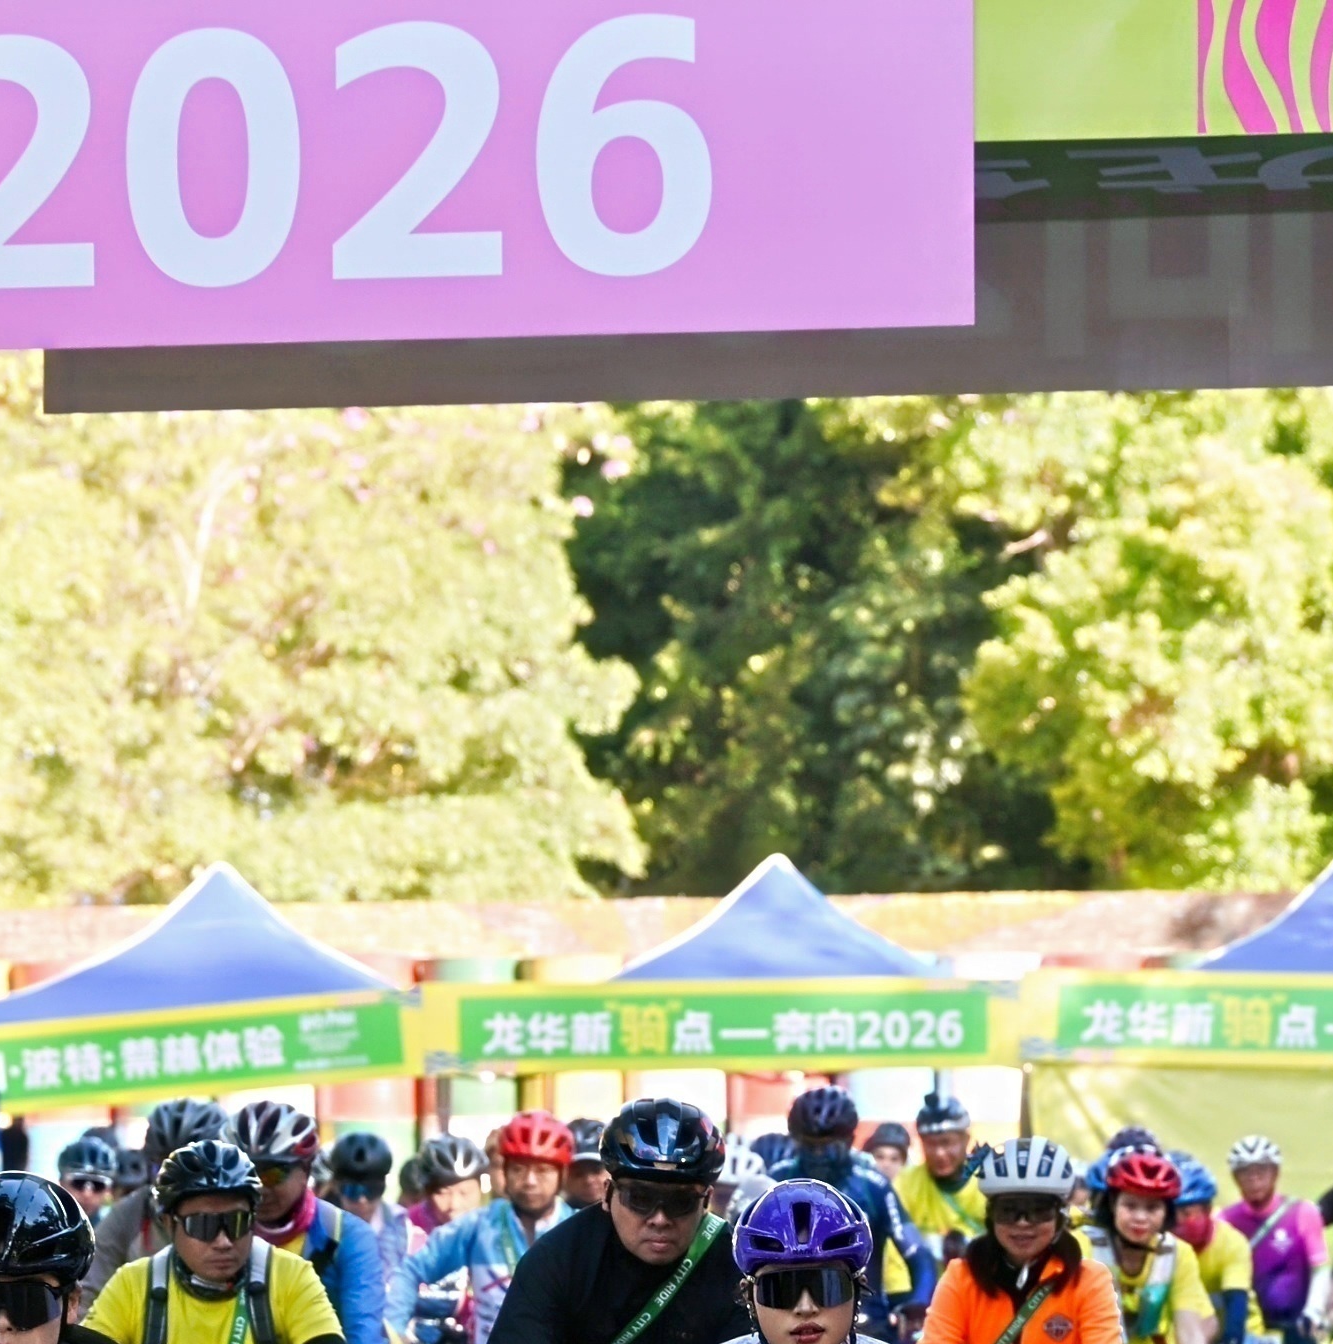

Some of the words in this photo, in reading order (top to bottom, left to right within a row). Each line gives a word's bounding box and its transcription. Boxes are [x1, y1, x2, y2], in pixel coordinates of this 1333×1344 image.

[676, 1257, 694, 1284] CITY
[654, 1282, 677, 1308] RIDE
[232, 1315, 247, 1340] CITY
[633, 1312, 652, 1334] CITY
